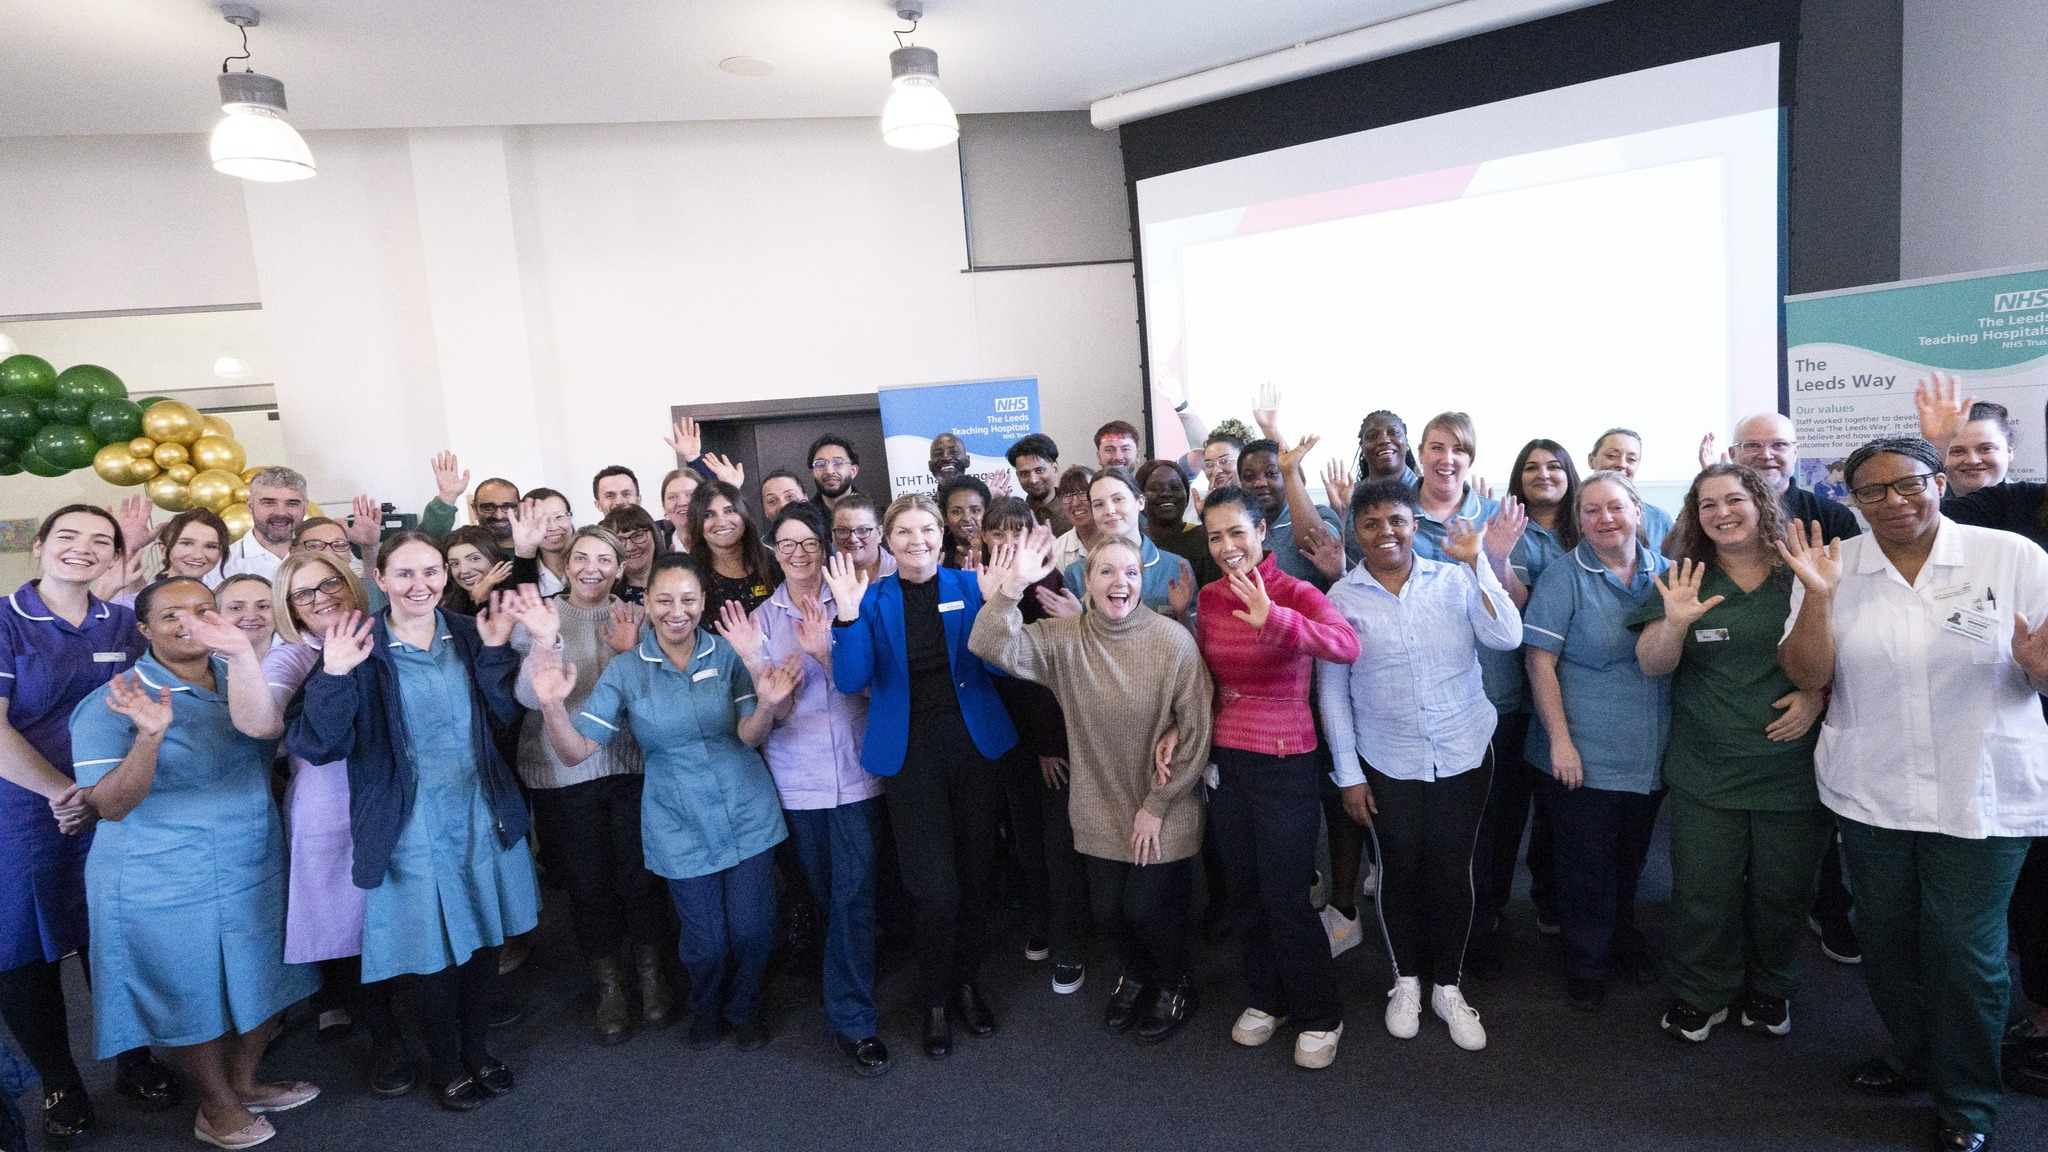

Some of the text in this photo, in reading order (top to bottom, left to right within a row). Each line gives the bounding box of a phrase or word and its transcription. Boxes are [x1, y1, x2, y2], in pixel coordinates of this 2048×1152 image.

[1996, 290, 2048, 311] NHS
[1977, 317, 2004, 328] The
[1918, 333, 1978, 346] Teaching
[2002, 339, 2048, 349] NHS Trus
[1795, 358, 1827, 373] The
[1796, 374, 1896, 392] Leeds Way
[996, 398, 1026, 411] NHS
[1796, 404, 1855, 415] Our values
[987, 413, 1029, 424] The Leeds
[1796, 417, 1811, 425] Staff
[1813, 416, 1842, 424] worked
[1844, 415, 1880, 424] together
[951, 423, 1030, 435] Teaching Hospitals
[895, 475, 923, 487] LTHT
